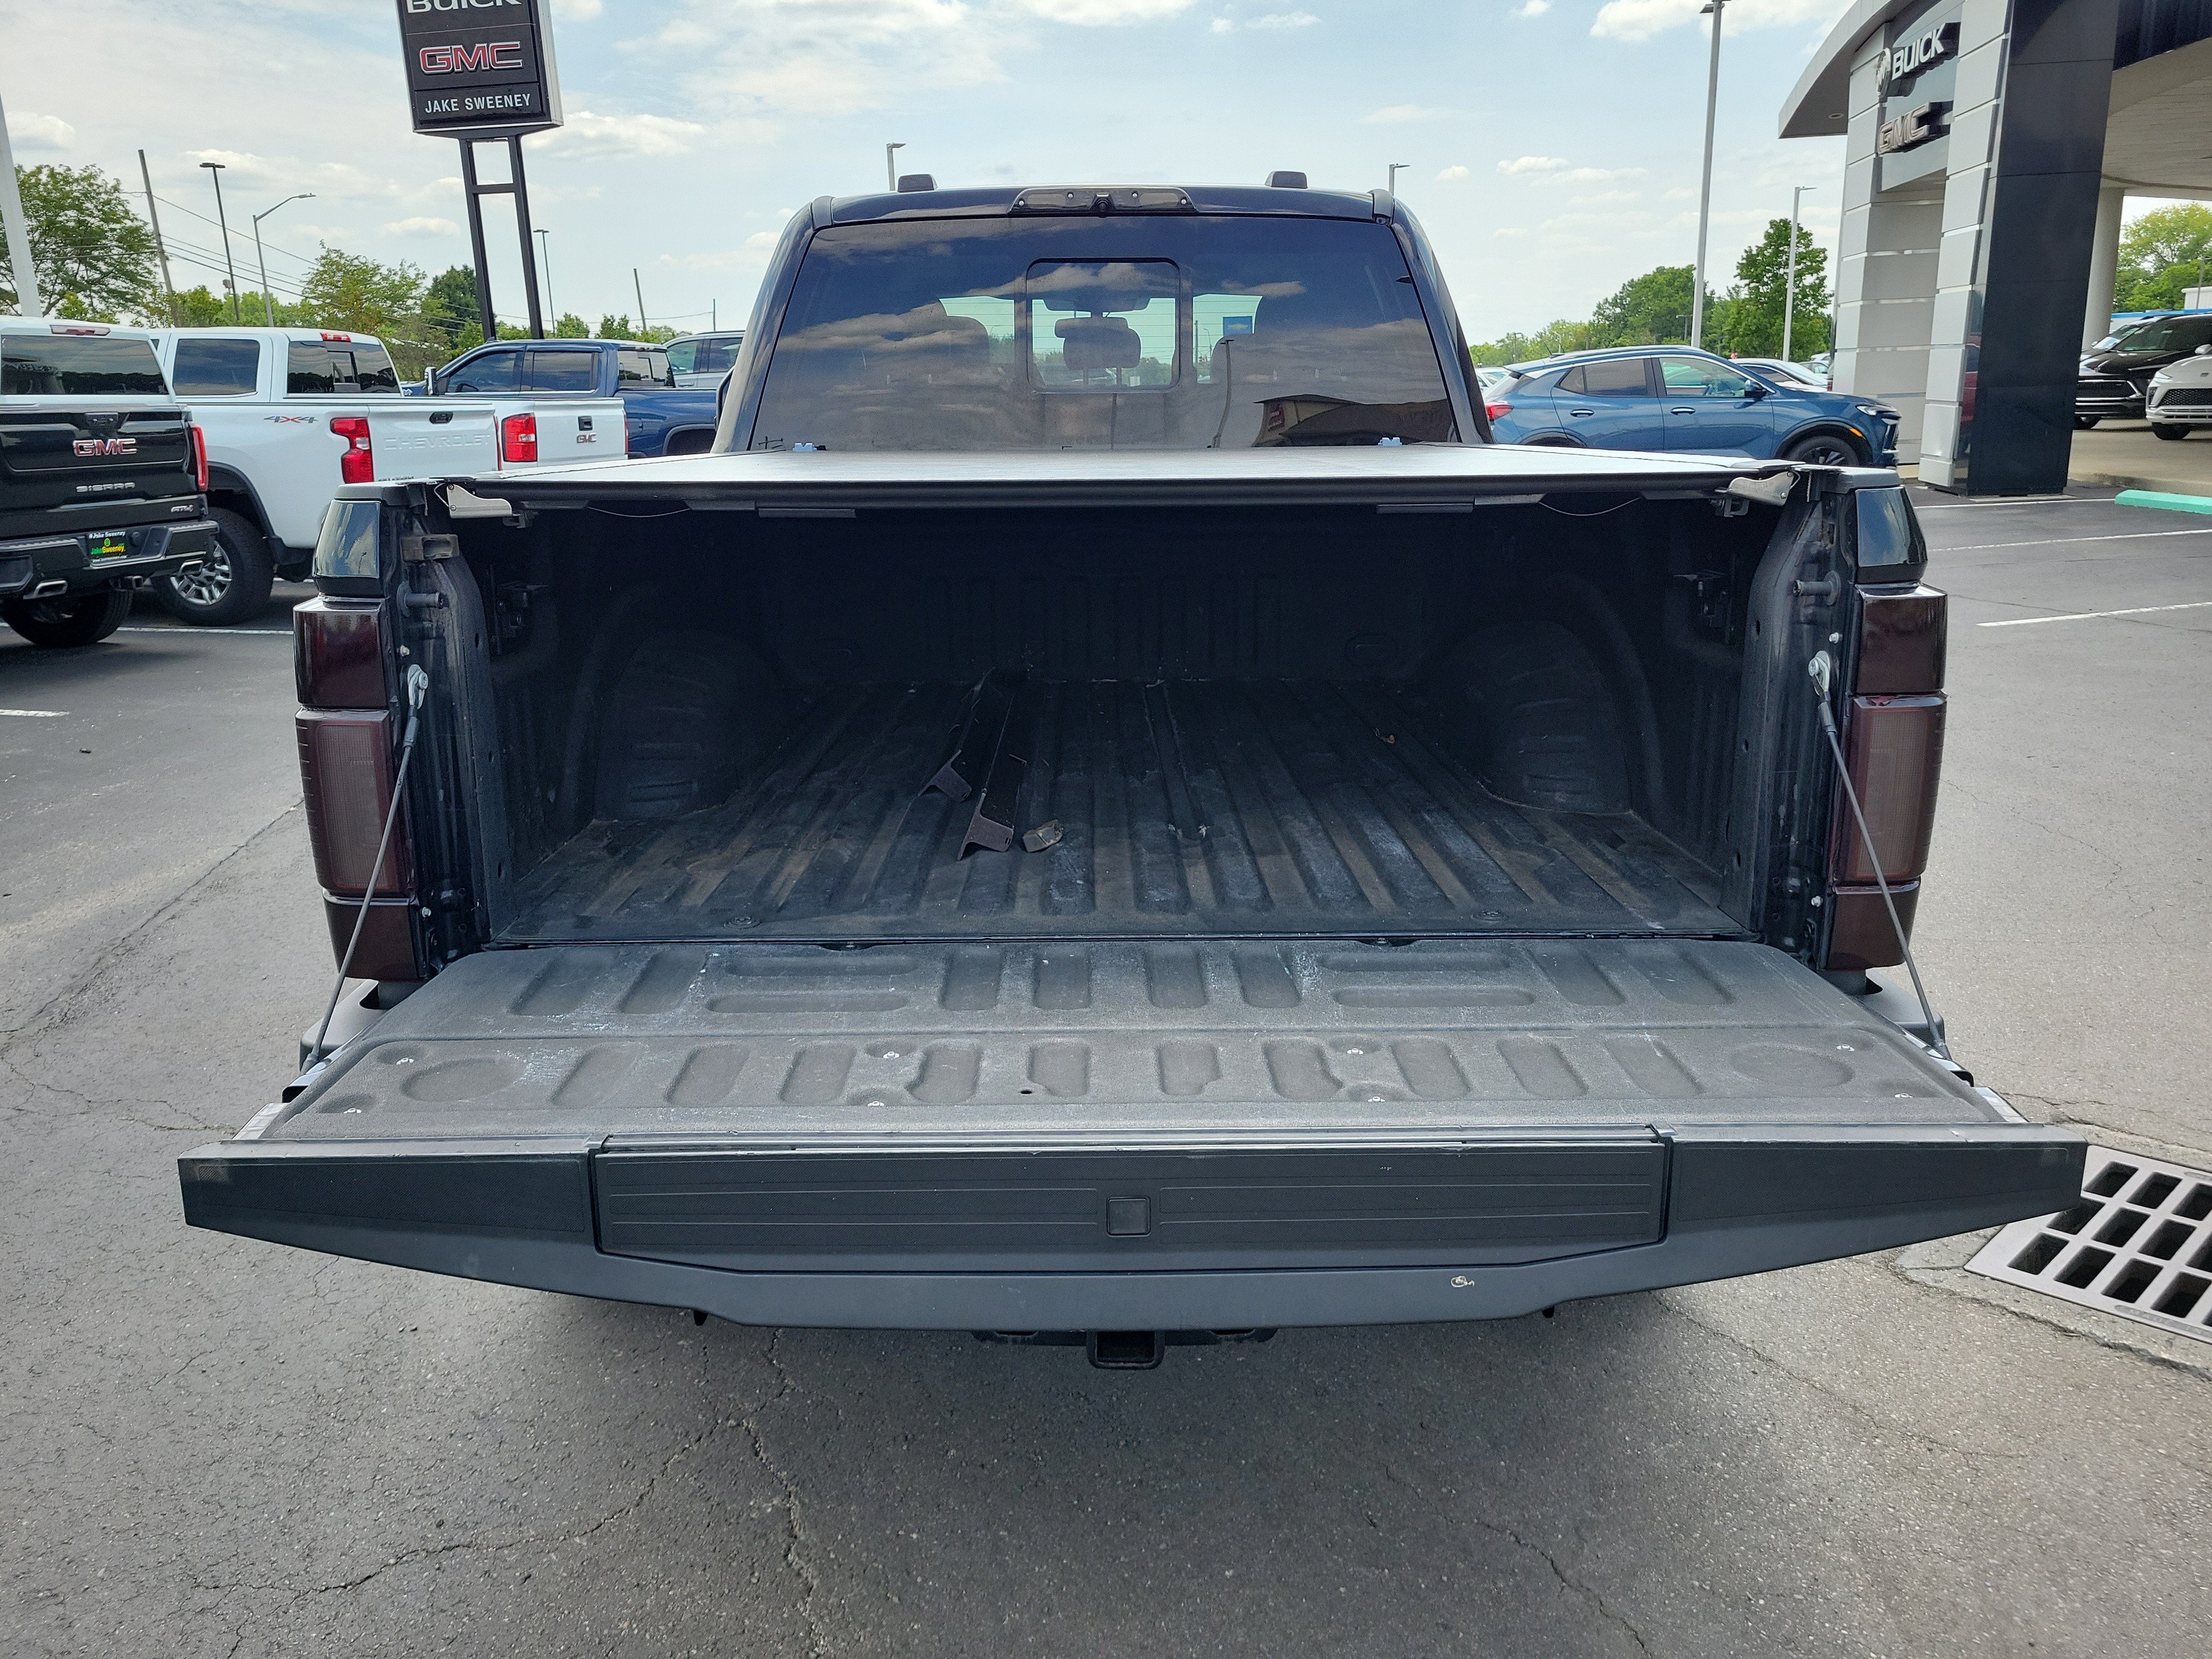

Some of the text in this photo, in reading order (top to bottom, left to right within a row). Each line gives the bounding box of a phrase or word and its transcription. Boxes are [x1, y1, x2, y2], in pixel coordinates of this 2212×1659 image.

[420, 41, 523, 75] GMC
[1891, 22, 1946, 81] BUICK
[425, 93, 531, 114] JAKE SWEENEY
[1878, 101, 1931, 155] GMC
[73, 438, 137, 456] GMC
